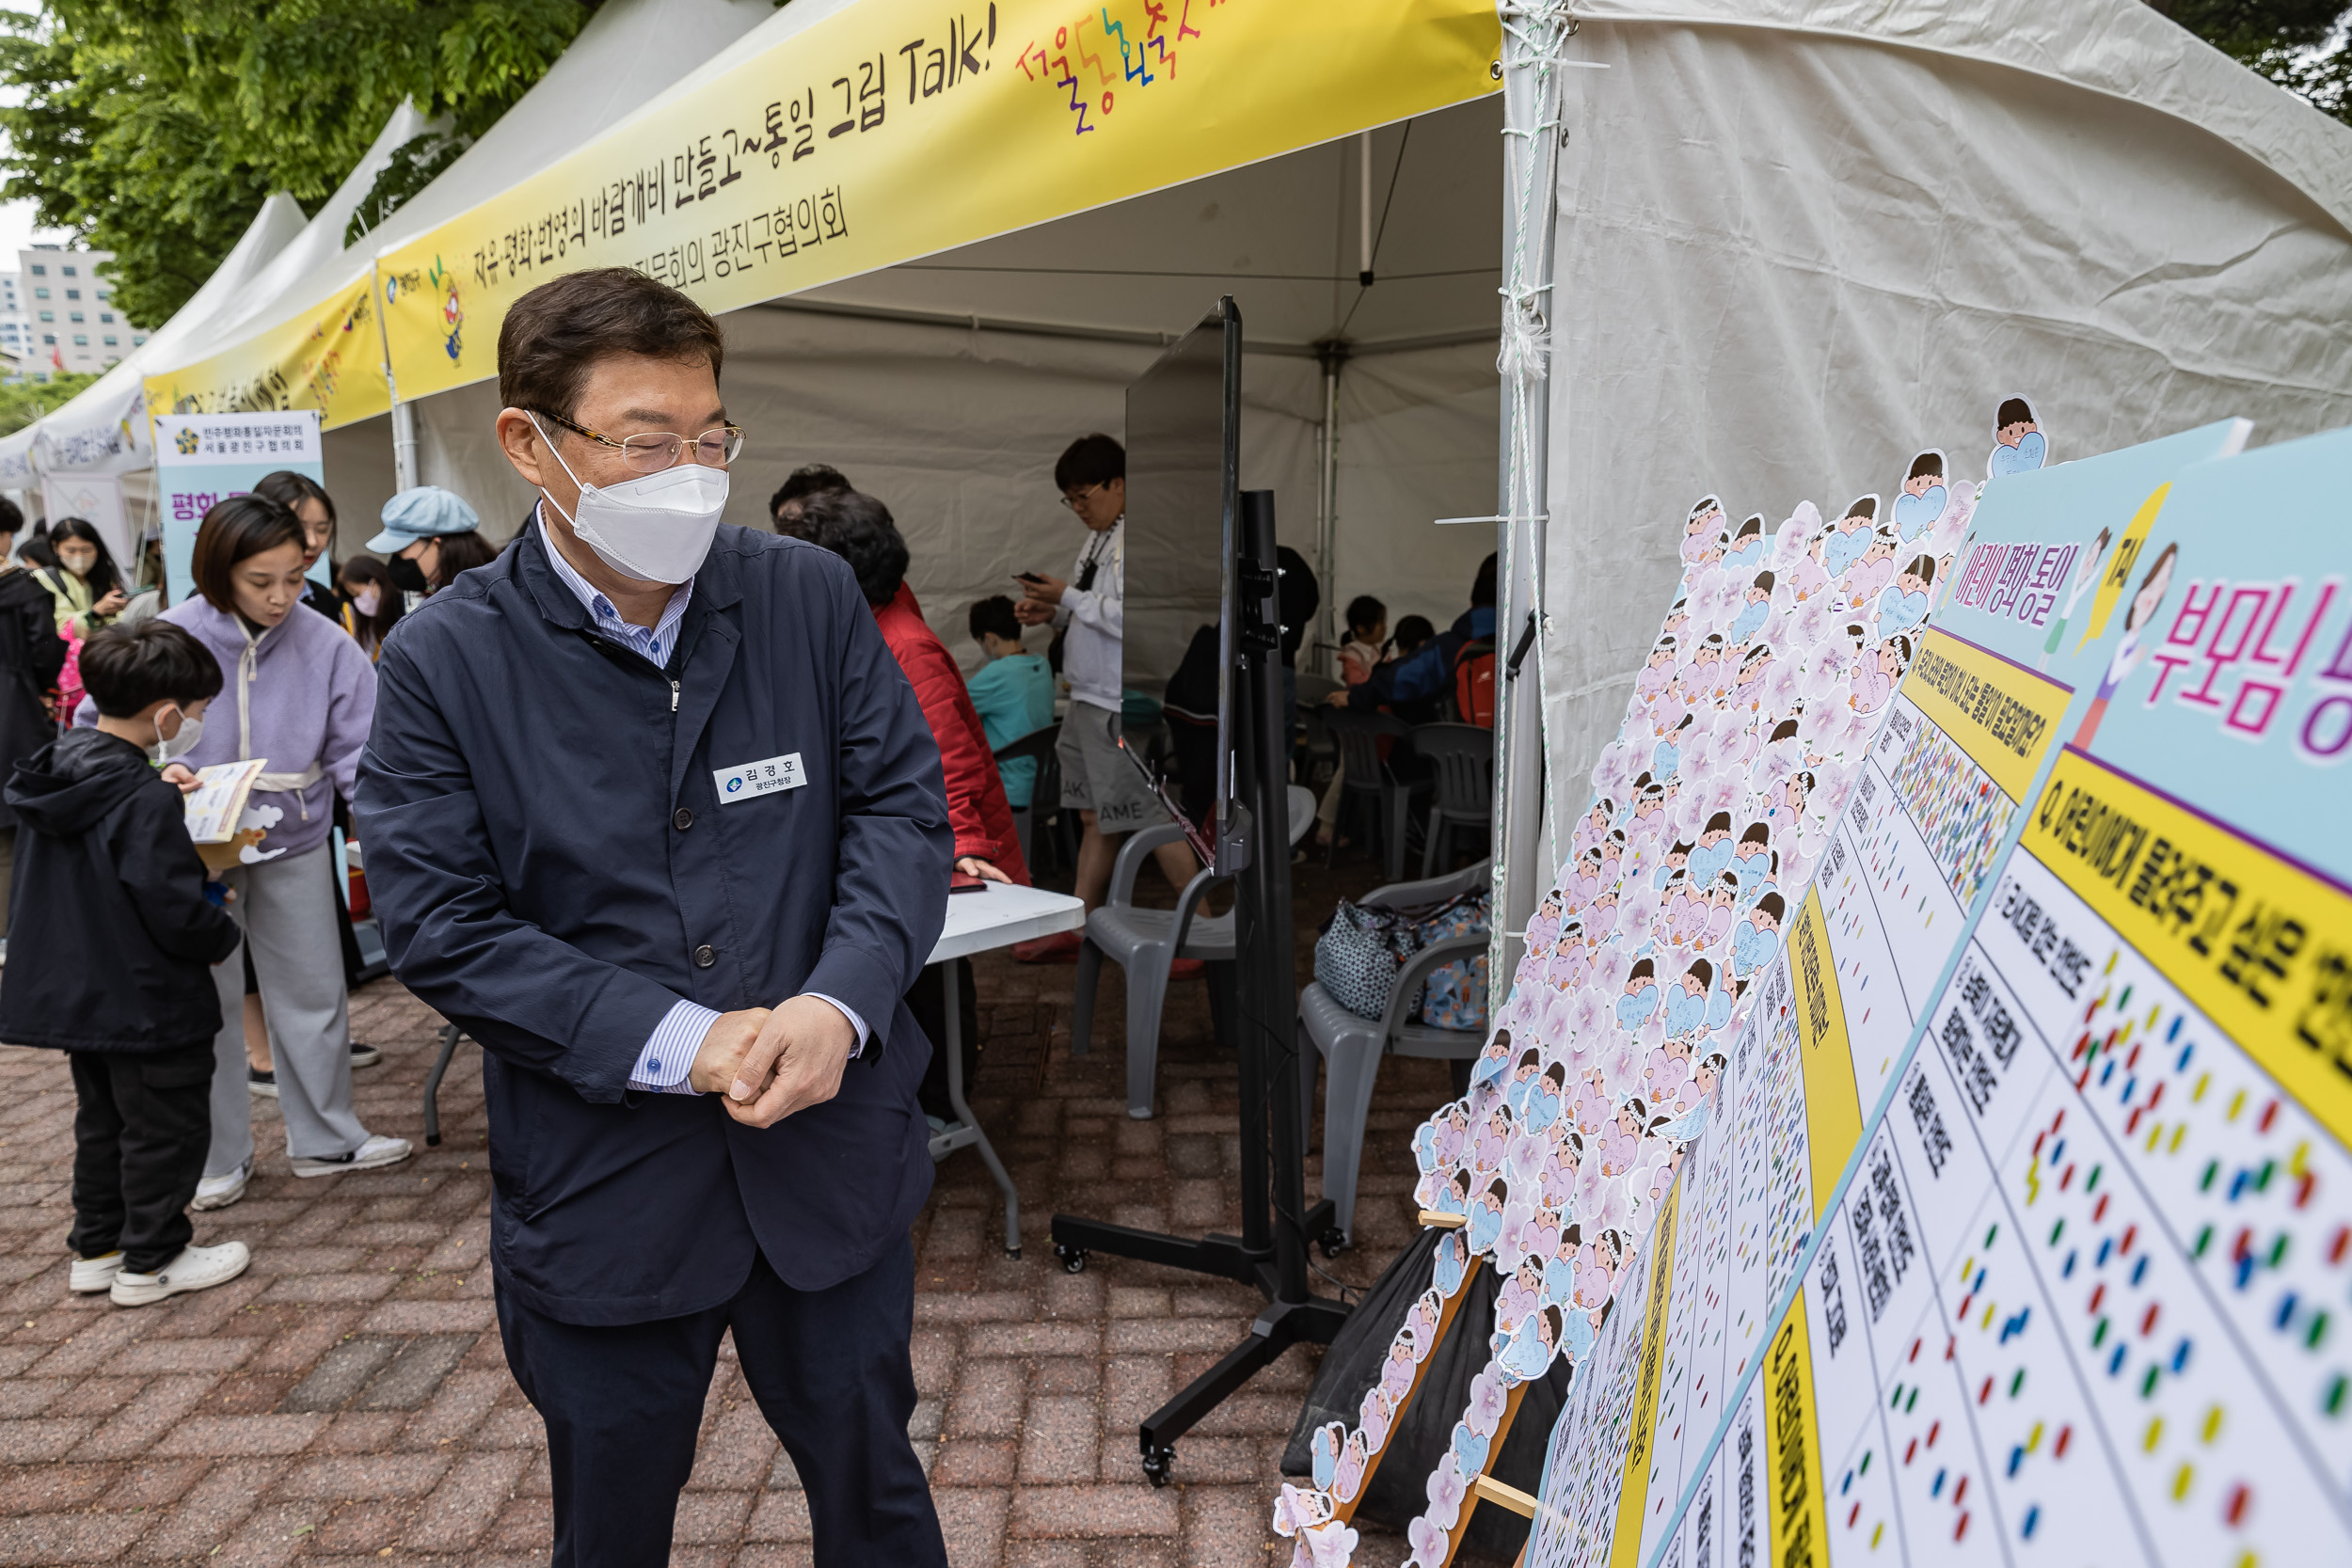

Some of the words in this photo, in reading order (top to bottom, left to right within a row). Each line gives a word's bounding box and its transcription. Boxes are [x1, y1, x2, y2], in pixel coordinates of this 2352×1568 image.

[590, 158, 666, 240] 바람개비
[827, 52, 886, 139] 그림
[899, 2, 997, 106] Talk!
[710, 184, 850, 278] 광진구협의회
[1955, 544, 2010, 609] 어린이
[1916, 650, 1944, 686] 우리나라와
[2149, 583, 2338, 735] 부모님
[755, 776, 791, 790] 광진구청장
[2052, 788, 2147, 887] 어린이에게
[2129, 840, 2239, 957] 물려주고
[2217, 898, 2308, 1010] 싶은
[2049, 938, 2091, 1000] 한반도
[1964, 1053, 1996, 1117] 한반도
[1924, 1114, 1951, 1178] 한반도
[1774, 1353, 1807, 1535] 어린이에게
